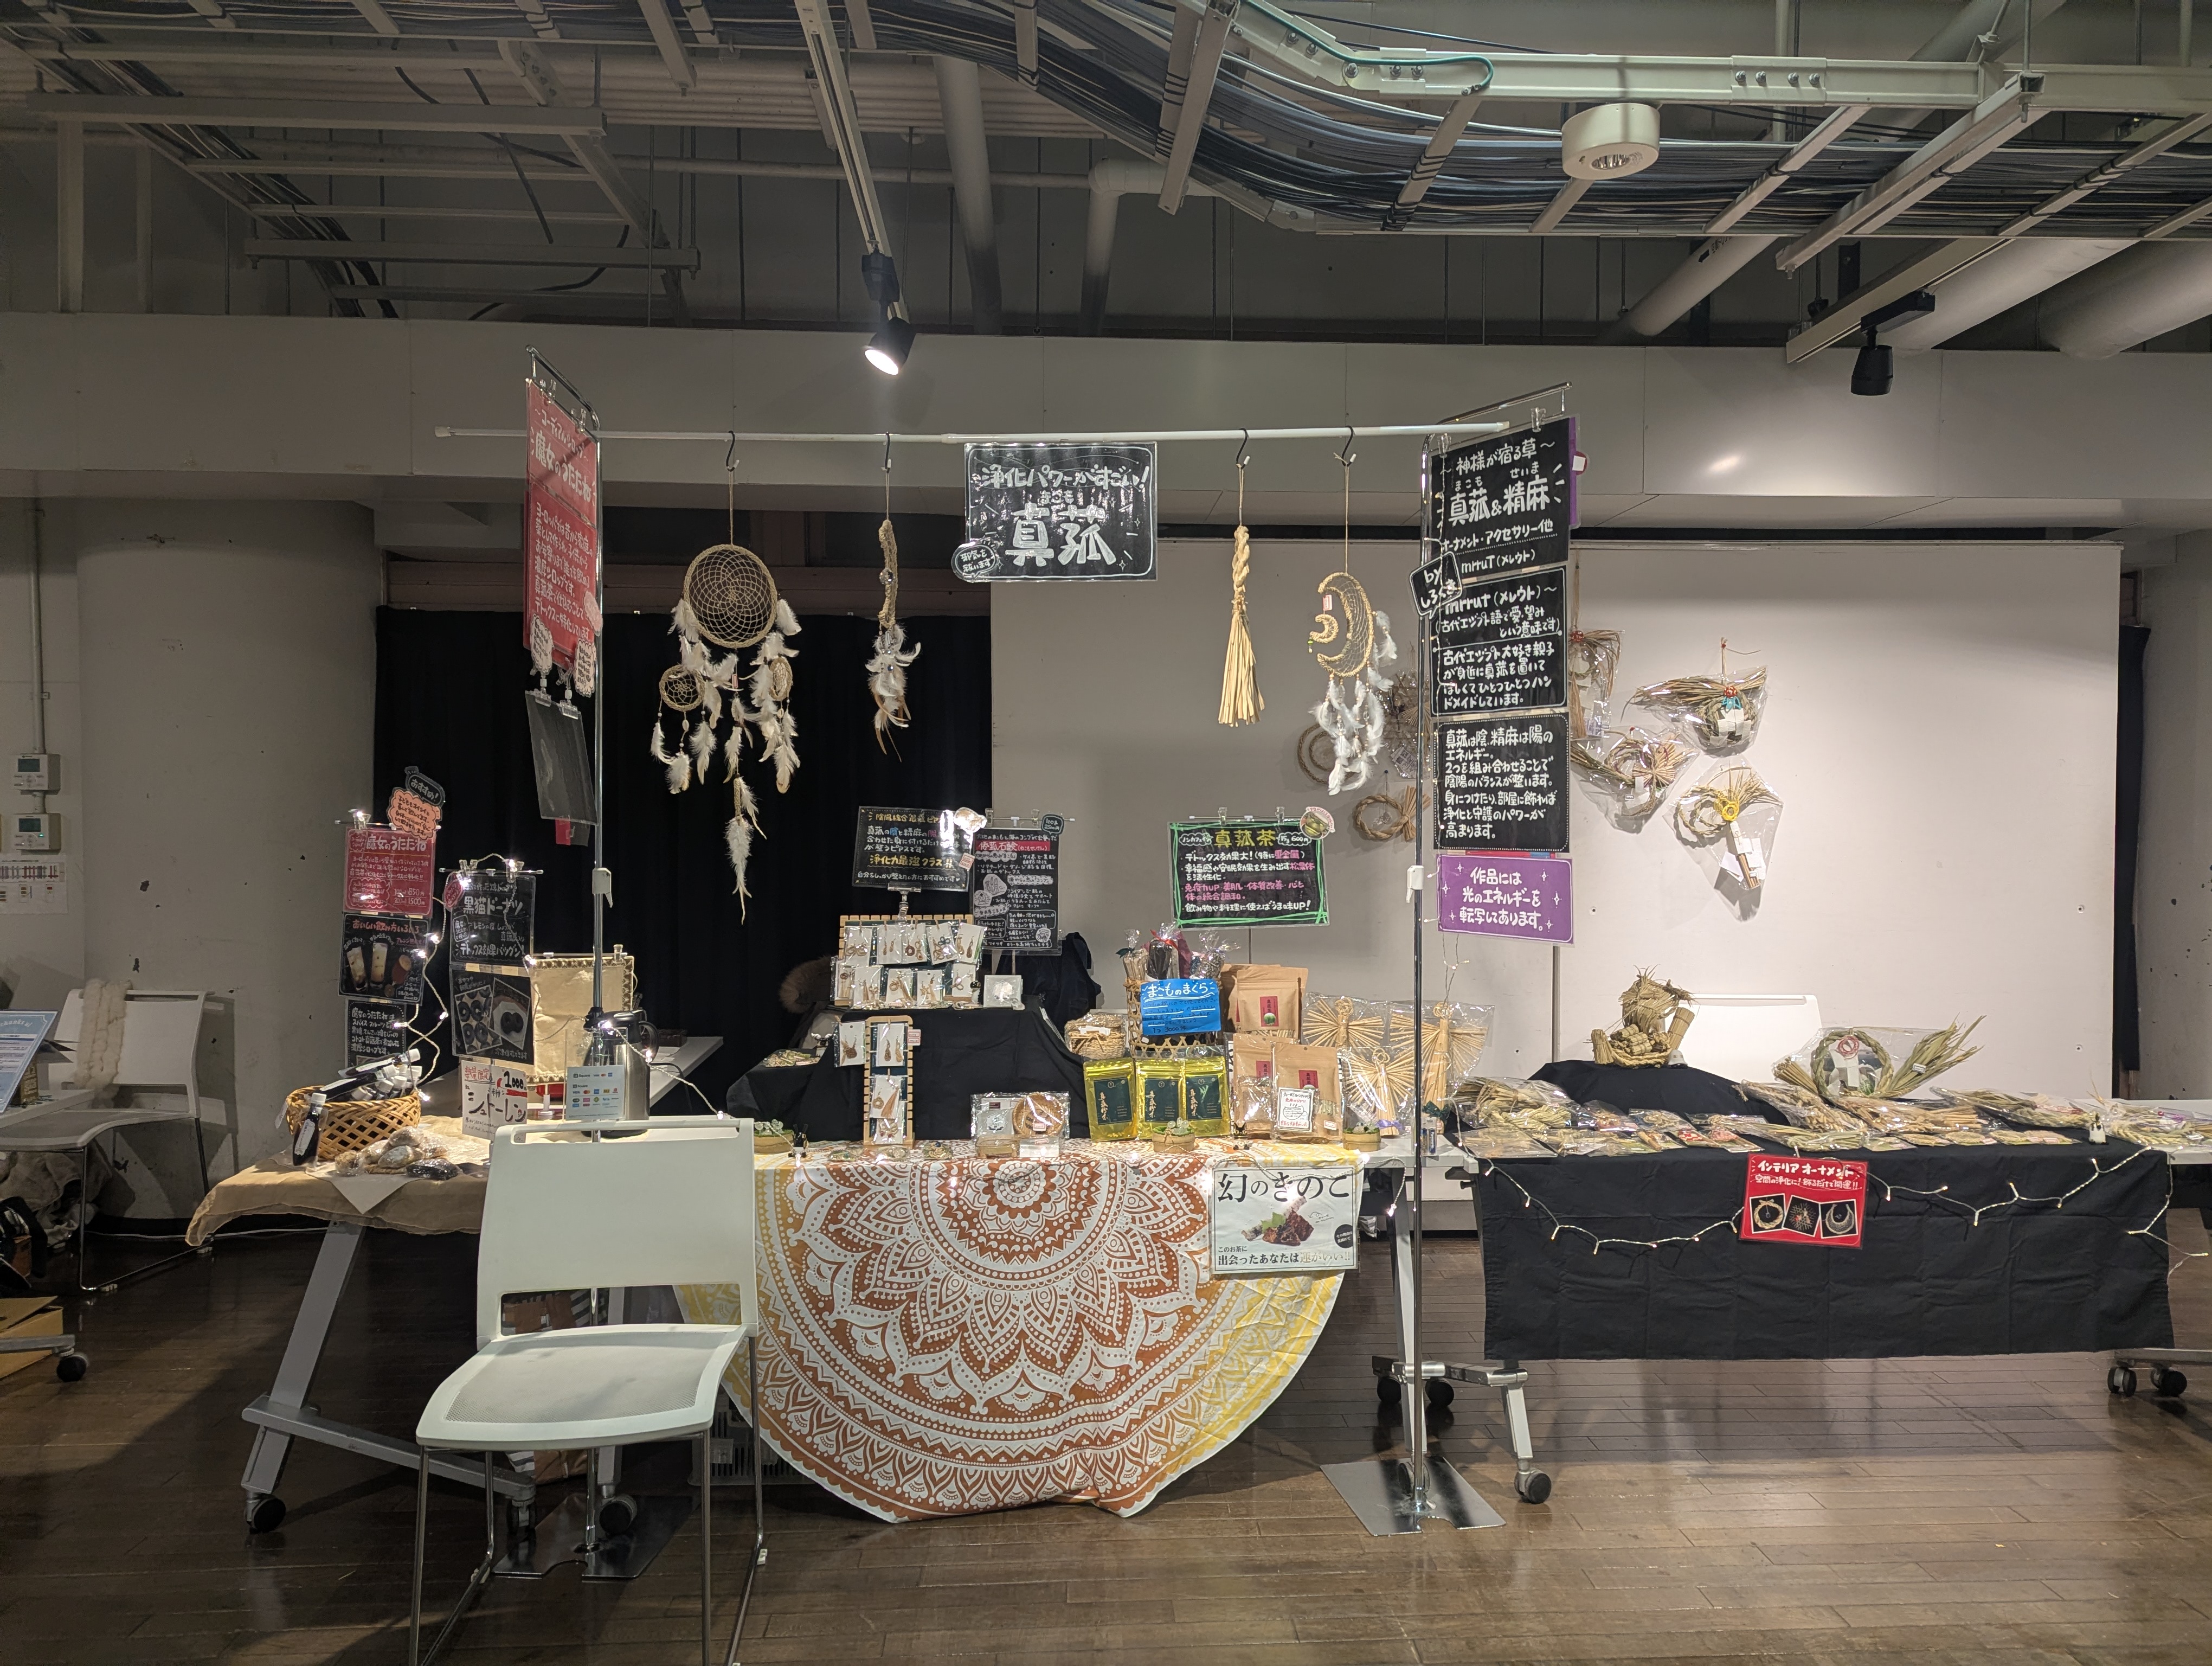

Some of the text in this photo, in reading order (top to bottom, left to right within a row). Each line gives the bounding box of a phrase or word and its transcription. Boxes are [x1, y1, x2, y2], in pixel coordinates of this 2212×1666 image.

[1510, 462, 1539, 479] せいま
[1455, 476, 1483, 491] まこも
[1039, 489, 1074, 504] まこも
[1443, 641, 1555, 666] 古代エジプト大好き親子
[1445, 756, 1554, 775] 2つを組み合わせることで
[1443, 806, 1547, 823] 浄化と守護のパワーが
[1214, 829, 1277, 848] 真菰茶
[1445, 821, 1496, 840] 高まります。
[366, 834, 427, 851] 魔女のうたたね
[1184, 862, 1315, 874] 幸福感や安眠効果を生み出す松果体
[1470, 866, 1522, 886] 作品には
[463, 895, 524, 915] 黒猫ドーナツ
[1462, 886, 1541, 907] 光のエネルギーを
[1459, 906, 1544, 932] 転写してあります。
[465, 1065, 490, 1080] 数量限定
[468, 1092, 526, 1123] シュトーレン
[1218, 1171, 1349, 1203] 幻のきのこ
[1218, 1245, 1248, 1253] このお茶に
